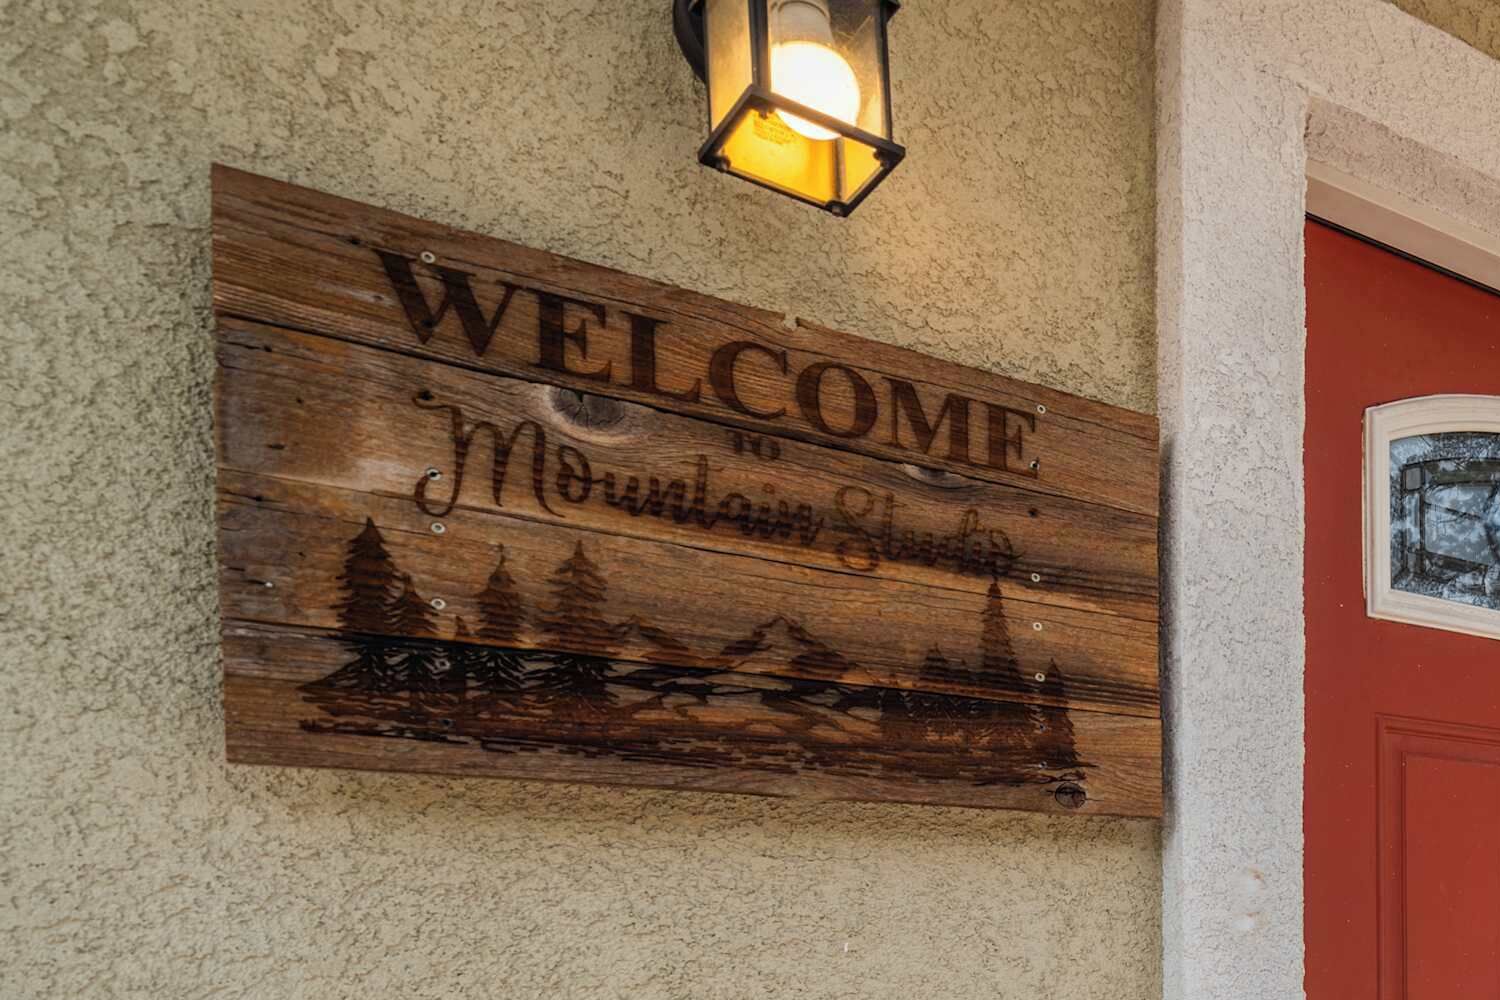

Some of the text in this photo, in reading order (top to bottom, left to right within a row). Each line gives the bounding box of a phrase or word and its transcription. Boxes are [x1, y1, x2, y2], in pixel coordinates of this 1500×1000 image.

[375, 250, 1039, 478] WELCOME
[412, 397, 826, 546] Mountain
[727, 430, 781, 461] TO
